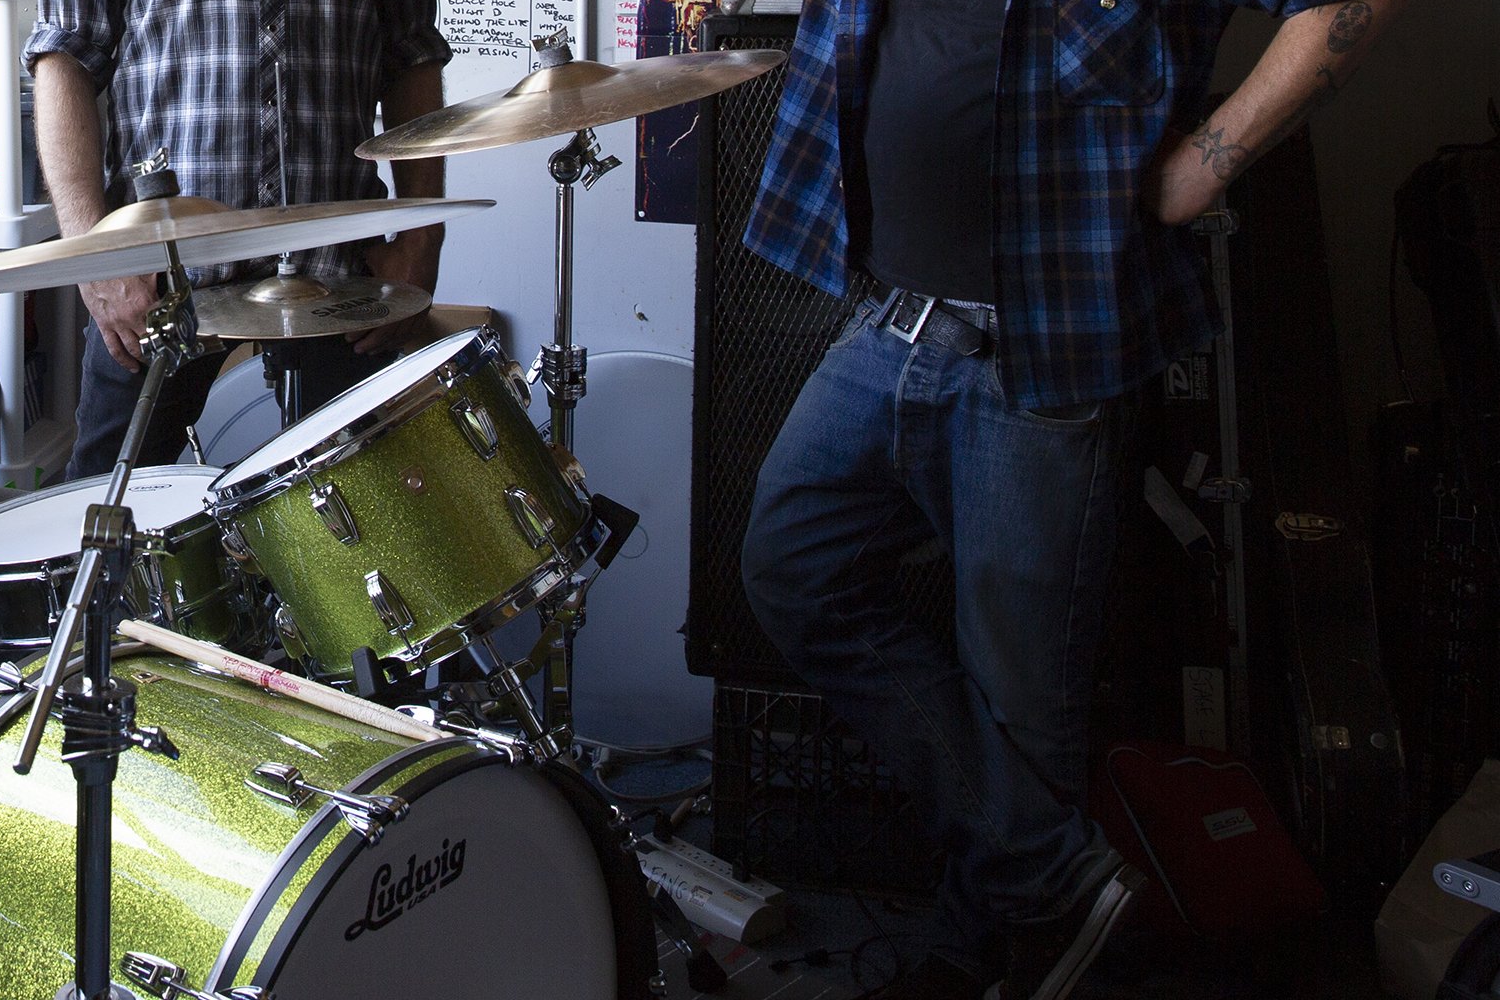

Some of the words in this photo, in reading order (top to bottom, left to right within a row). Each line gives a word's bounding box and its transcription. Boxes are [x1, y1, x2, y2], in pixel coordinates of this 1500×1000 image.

[491, 0, 516, 8] HOLE
[535, 2, 557, 10] OVER
[452, 7, 485, 16] NIGHT
[493, 8, 502, 17] D
[443, 17, 481, 26] BEHIND
[485, 18, 506, 27] THE
[553, 14, 575, 22] EDGE
[539, 22, 563, 32] WHY?
[449, 27, 466, 35] THE
[471, 28, 514, 38] MEADOWS
[483, 35, 527, 48] WATER
[478, 47, 518, 60] RISING
[311, 296, 380, 318] SABIAN
[344, 838, 467, 941] Ludwig
[407, 885, 438, 910] USA
